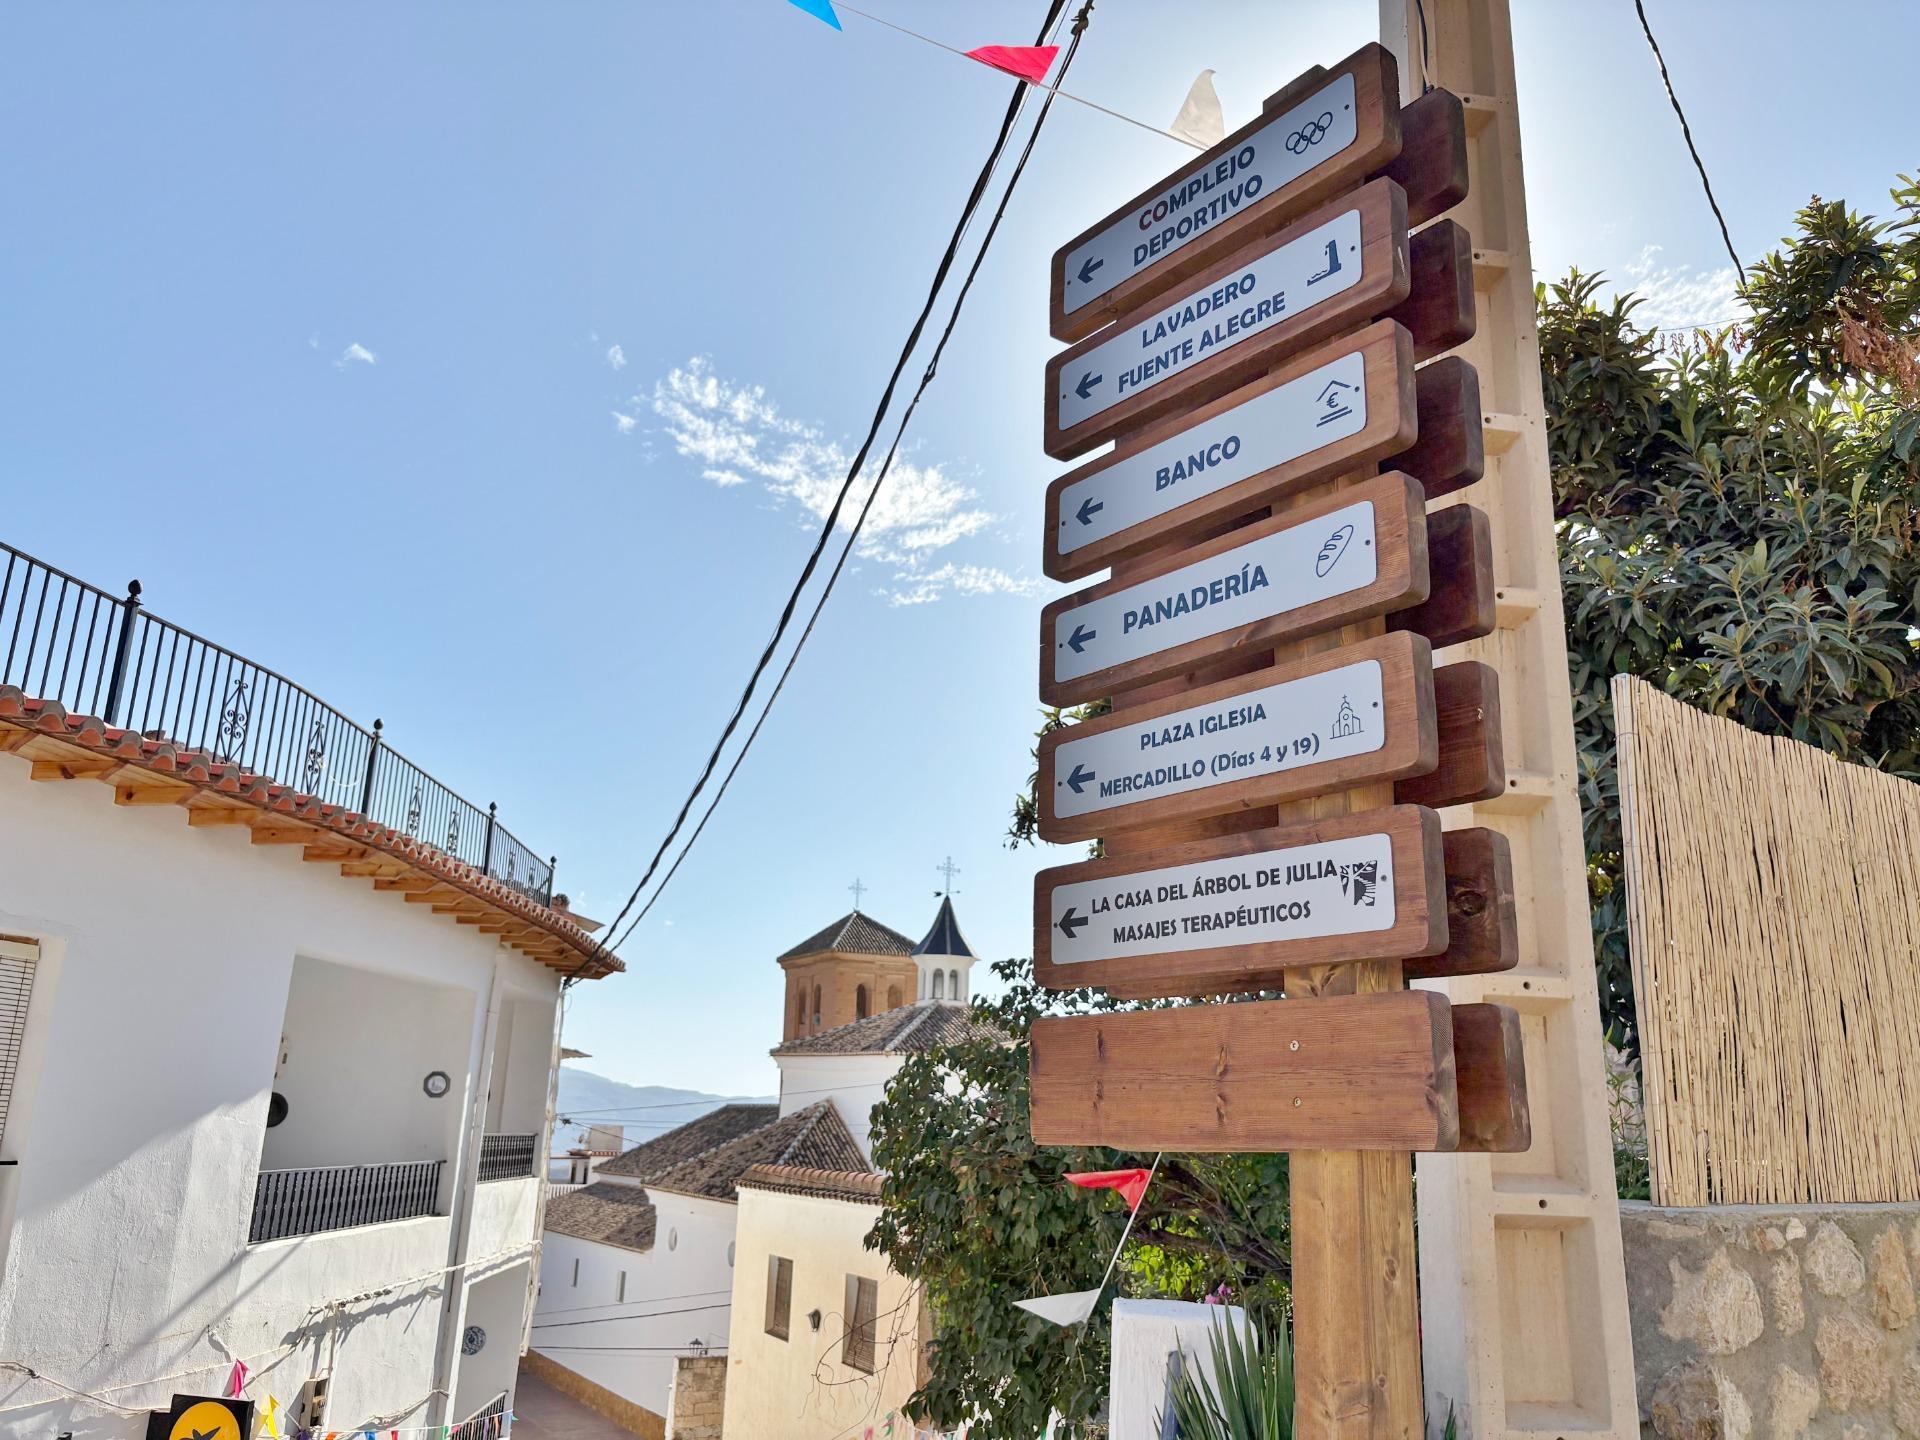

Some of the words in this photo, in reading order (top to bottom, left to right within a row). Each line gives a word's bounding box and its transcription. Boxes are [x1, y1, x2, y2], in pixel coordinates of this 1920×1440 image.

[1133, 174, 1263, 268] DEPORTIVO
[1138, 145, 1256, 232] COMPLEJO
[1118, 337, 1194, 394] FUENTE
[1198, 290, 1286, 353] ALEGRE
[1142, 273, 1257, 349] LAVADERO
[1155, 435, 1241, 492] BANCO
[1123, 562, 1270, 635] PANADERÍA
[1140, 721, 1196, 751] PLAZA
[1199, 703, 1267, 736] IGLESIA
[1099, 759, 1206, 798] MERCADILLO
[1210, 751, 1256, 778] (Días
[1259, 745, 1272, 762] 4
[1276, 744, 1288, 763] y
[1292, 732, 1321, 758] 19)
[1091, 896, 1111, 915] LA
[1114, 888, 1154, 911] CASA
[1157, 883, 1189, 904] DEL
[1191, 872, 1252, 898] ÁRBOL
[1255, 867, 1281, 889] DE
[1285, 858, 1338, 887] JULIA
[1113, 918, 1178, 944] MASAJES
[1180, 899, 1312, 934] TERAPÉUTICOS
